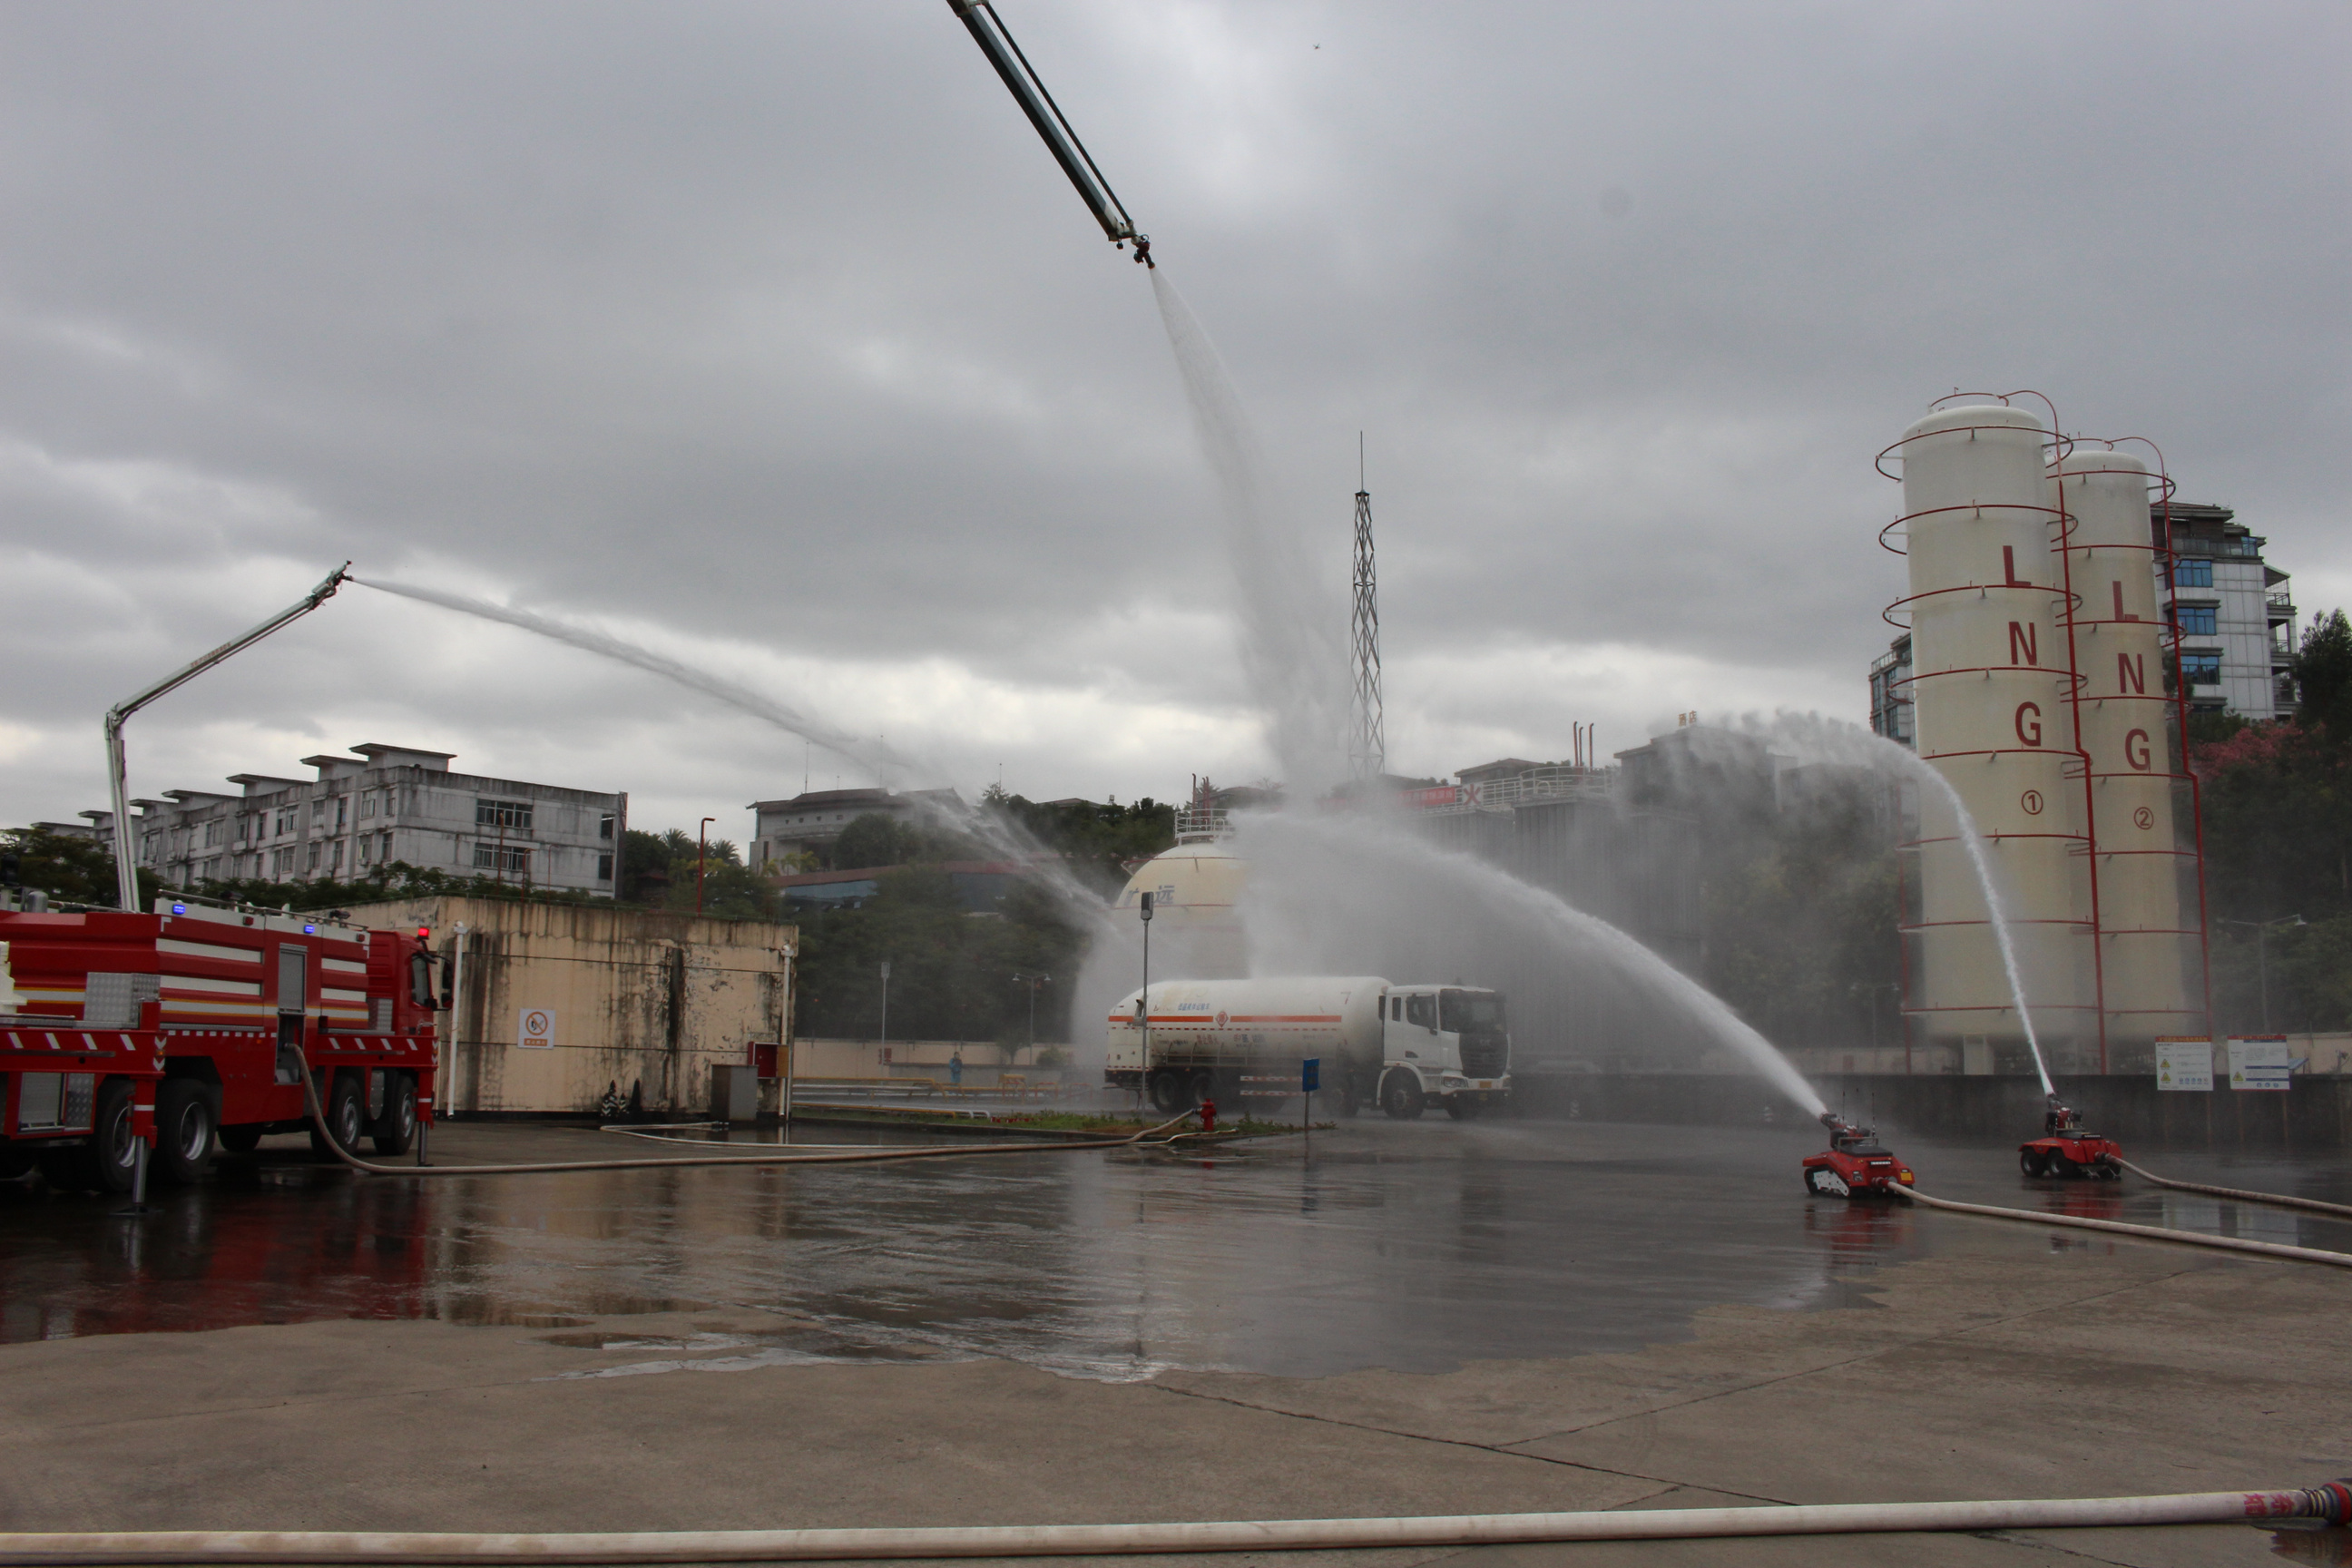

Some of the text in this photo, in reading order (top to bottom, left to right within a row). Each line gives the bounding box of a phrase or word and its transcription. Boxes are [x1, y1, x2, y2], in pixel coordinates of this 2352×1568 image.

[2002, 544, 2043, 748] LNG
[2112, 580, 2151, 771] LNG
[1679, 710, 1697, 726] 酒店
[1463, 783, 1482, 806] 火
